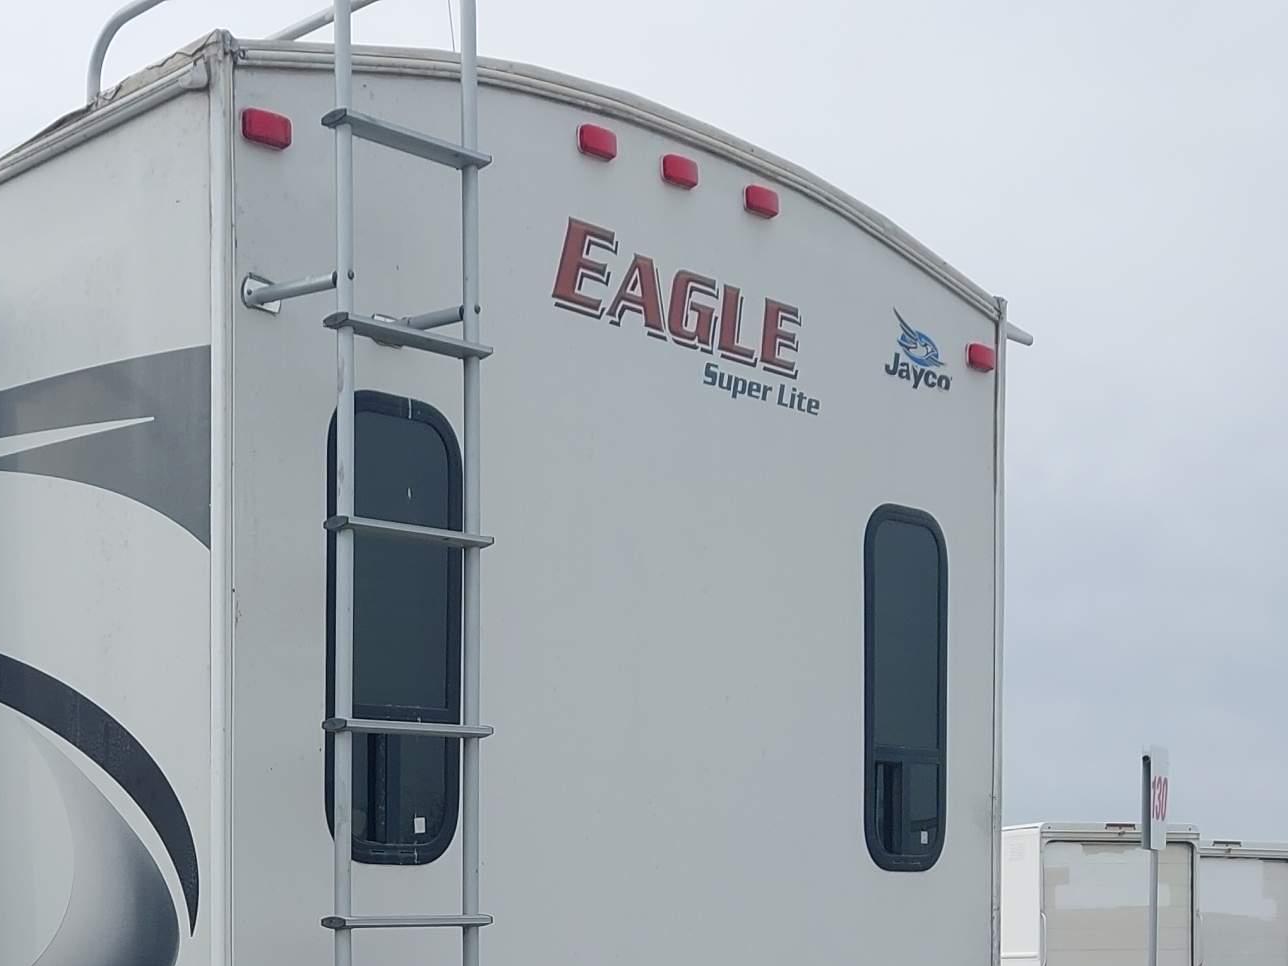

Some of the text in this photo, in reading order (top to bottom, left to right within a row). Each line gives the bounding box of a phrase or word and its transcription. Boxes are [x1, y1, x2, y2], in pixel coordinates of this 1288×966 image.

[552, 217, 802, 379] EAGLE
[703, 362, 820, 416] Super Lite
[884, 352, 951, 391] Jayco
[1151, 776, 1168, 821] 130
